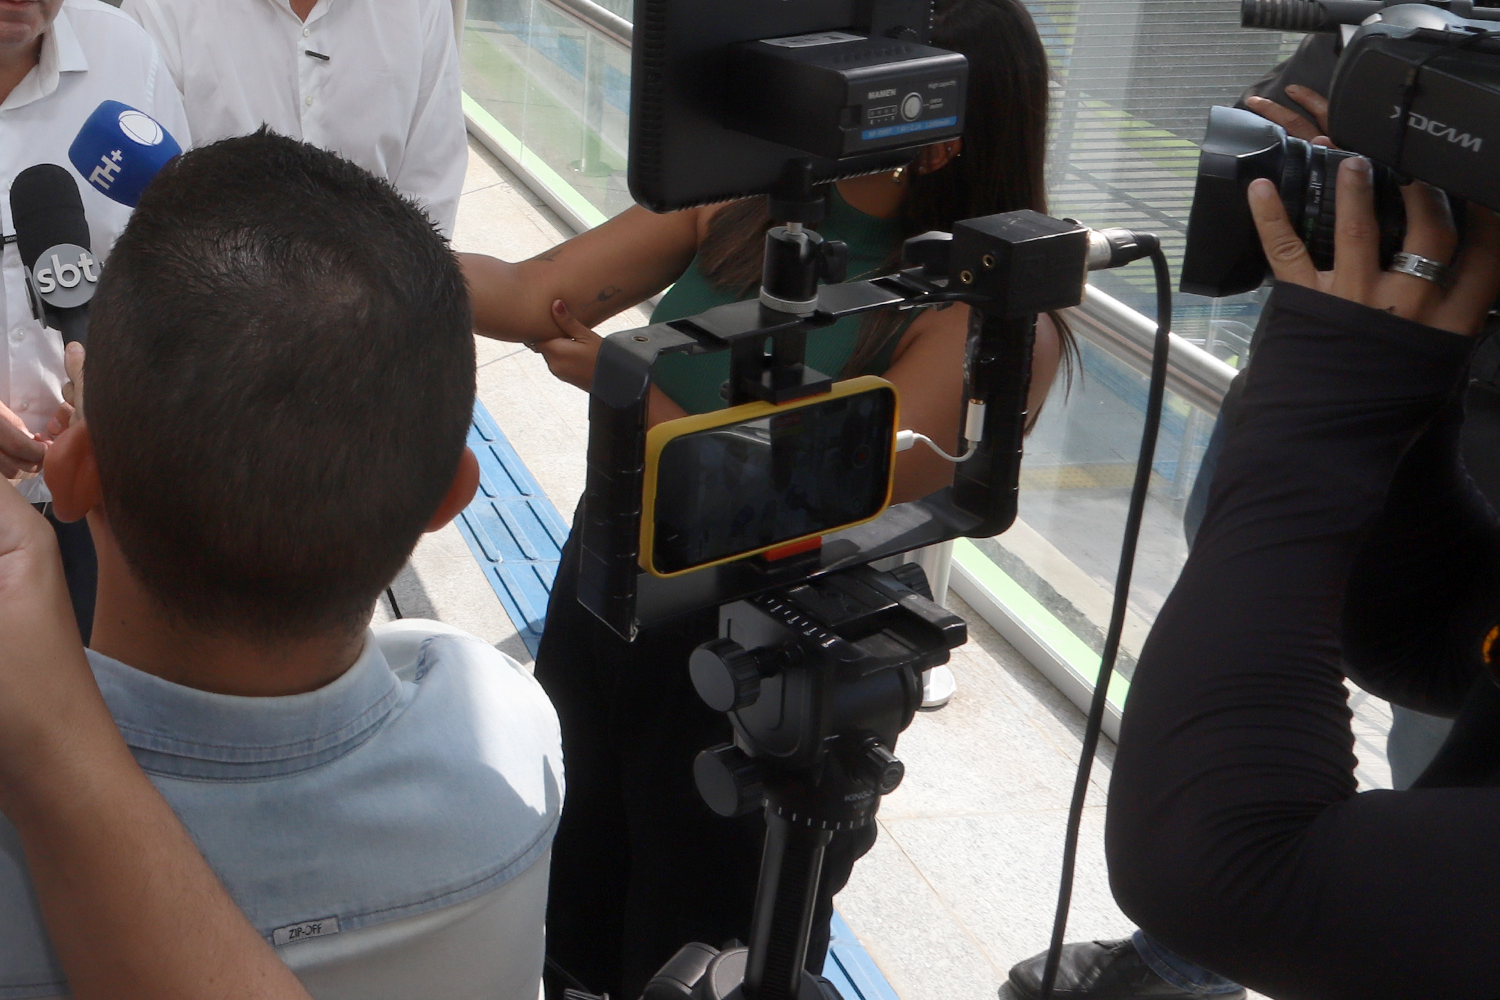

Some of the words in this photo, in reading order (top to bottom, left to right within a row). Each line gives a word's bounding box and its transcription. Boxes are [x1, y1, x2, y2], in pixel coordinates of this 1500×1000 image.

[867, 88, 897, 100] MAMEN
[37, 252, 98, 294] sbt
[288, 923, 323, 940] ZIP-OFF
